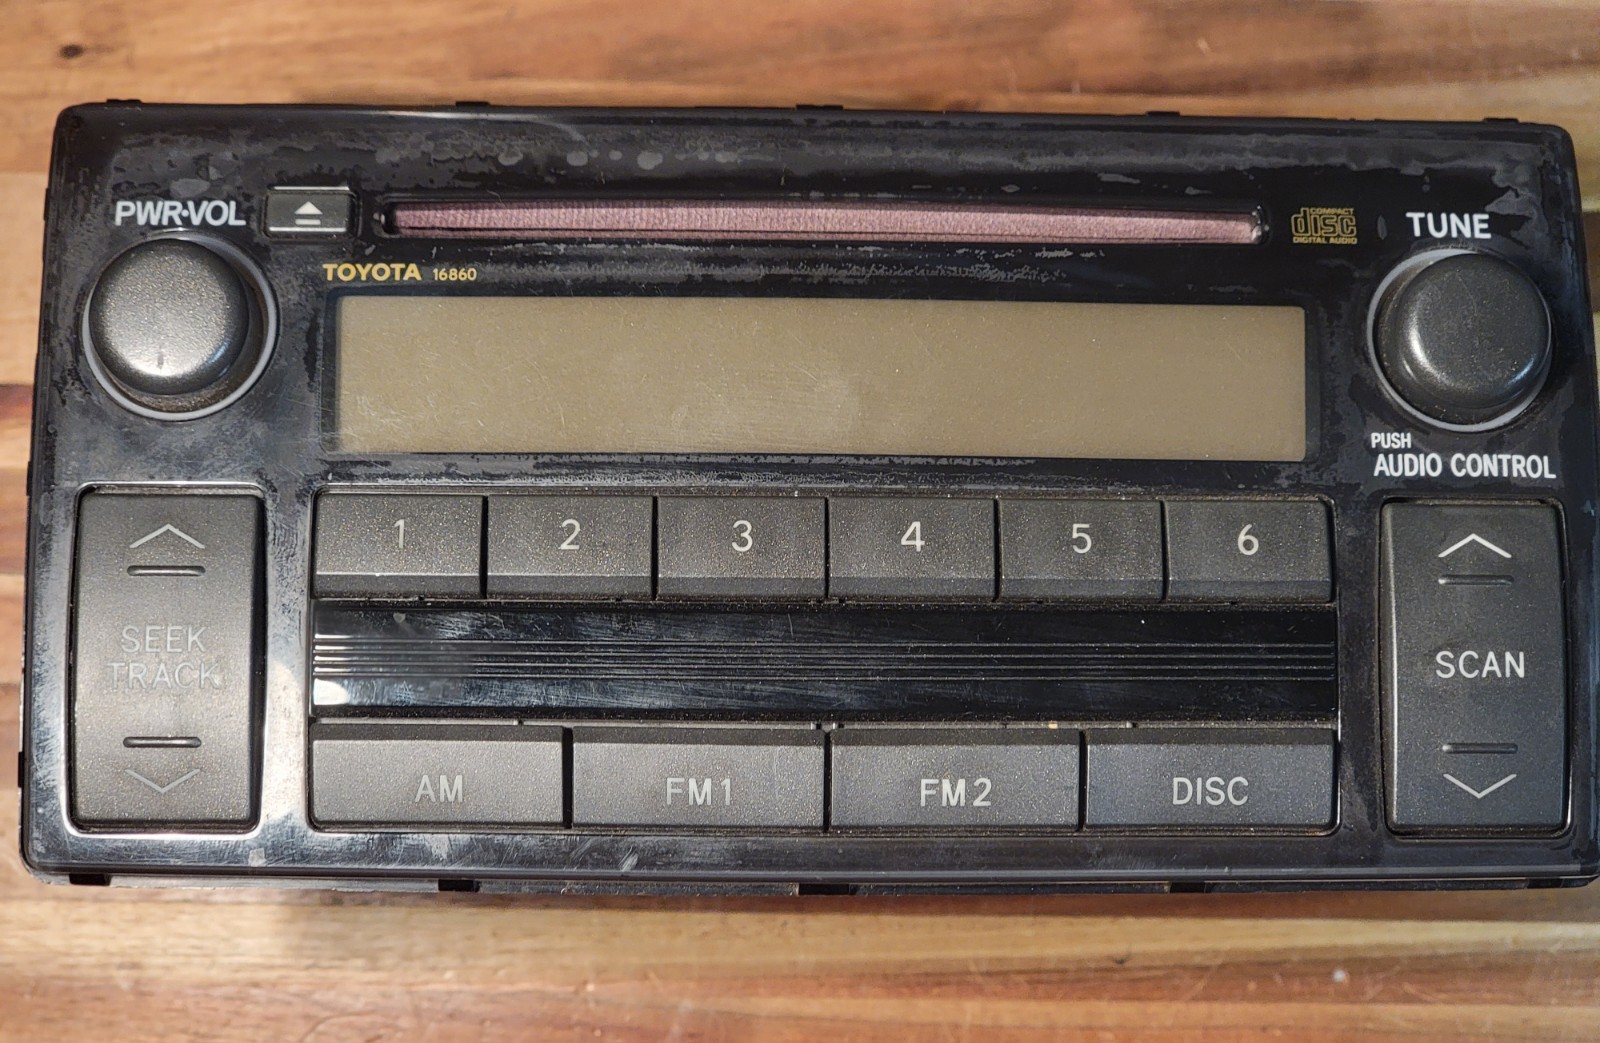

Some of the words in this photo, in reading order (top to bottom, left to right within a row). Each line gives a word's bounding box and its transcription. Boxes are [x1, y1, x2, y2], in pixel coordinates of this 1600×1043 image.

[1406, 212, 1492, 239] TUNE
[1329, 237, 1358, 245] AUDIO
[322, 263, 422, 281] TOYOTA
[433, 268, 478, 281] 16860
[1371, 432, 1412, 449] PUSH
[1373, 454, 1443, 478] AUDIO
[1450, 454, 1557, 479] CONTROL
[393, 520, 406, 549] 1
[560, 520, 581, 550] 2
[731, 521, 754, 553] 3
[900, 521, 925, 552] 4
[1071, 524, 1093, 555] 5
[1237, 525, 1259, 555] 6
[121, 625, 207, 653] SEEK
[106, 662, 219, 689] TRACK
[1435, 650, 1526, 678] SCAN
[415, 775, 464, 802] AM
[1172, 777, 1249, 806] DISC
